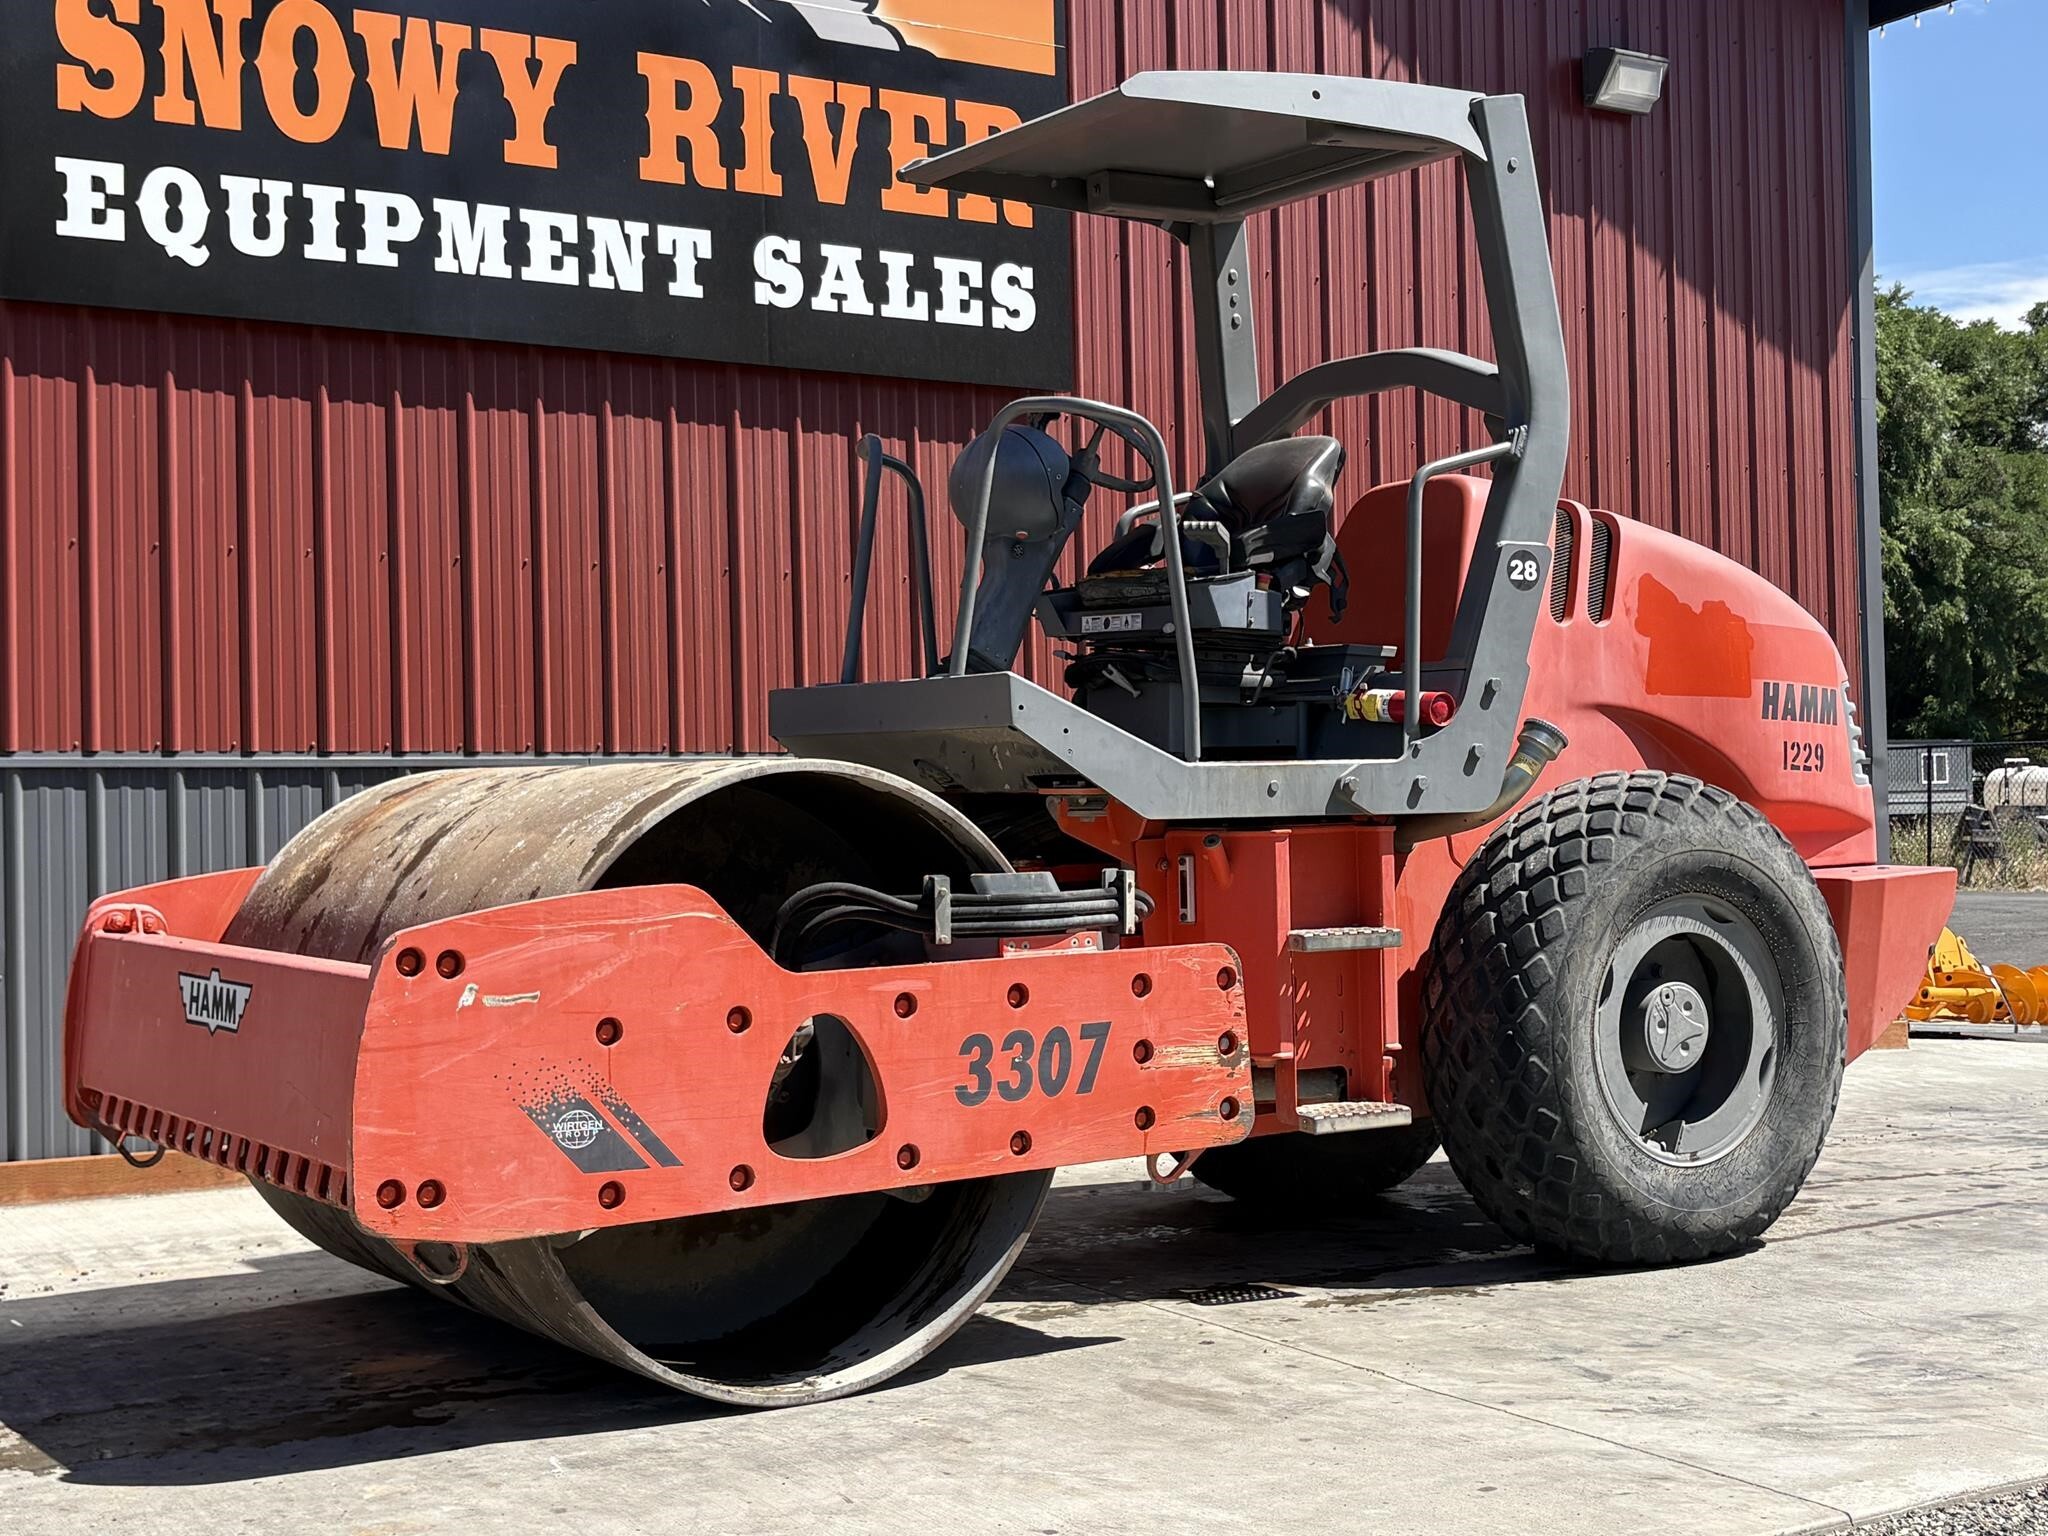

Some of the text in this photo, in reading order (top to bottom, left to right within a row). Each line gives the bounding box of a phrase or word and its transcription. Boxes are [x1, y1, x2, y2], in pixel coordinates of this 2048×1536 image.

[55, 0, 577, 169] SNOWY
[55, 156, 1036, 332] EQUIPMENT SALES
[1510, 559, 1537, 581] 28
[1762, 682, 1837, 726] HAMM
[1783, 741, 1824, 772] 1229
[189, 981, 236, 1024] HAMM
[955, 1021, 1112, 1106] 3307
[552, 1119, 603, 1131] WIRTGEN
[556, 1130, 598, 1138] GROUP
